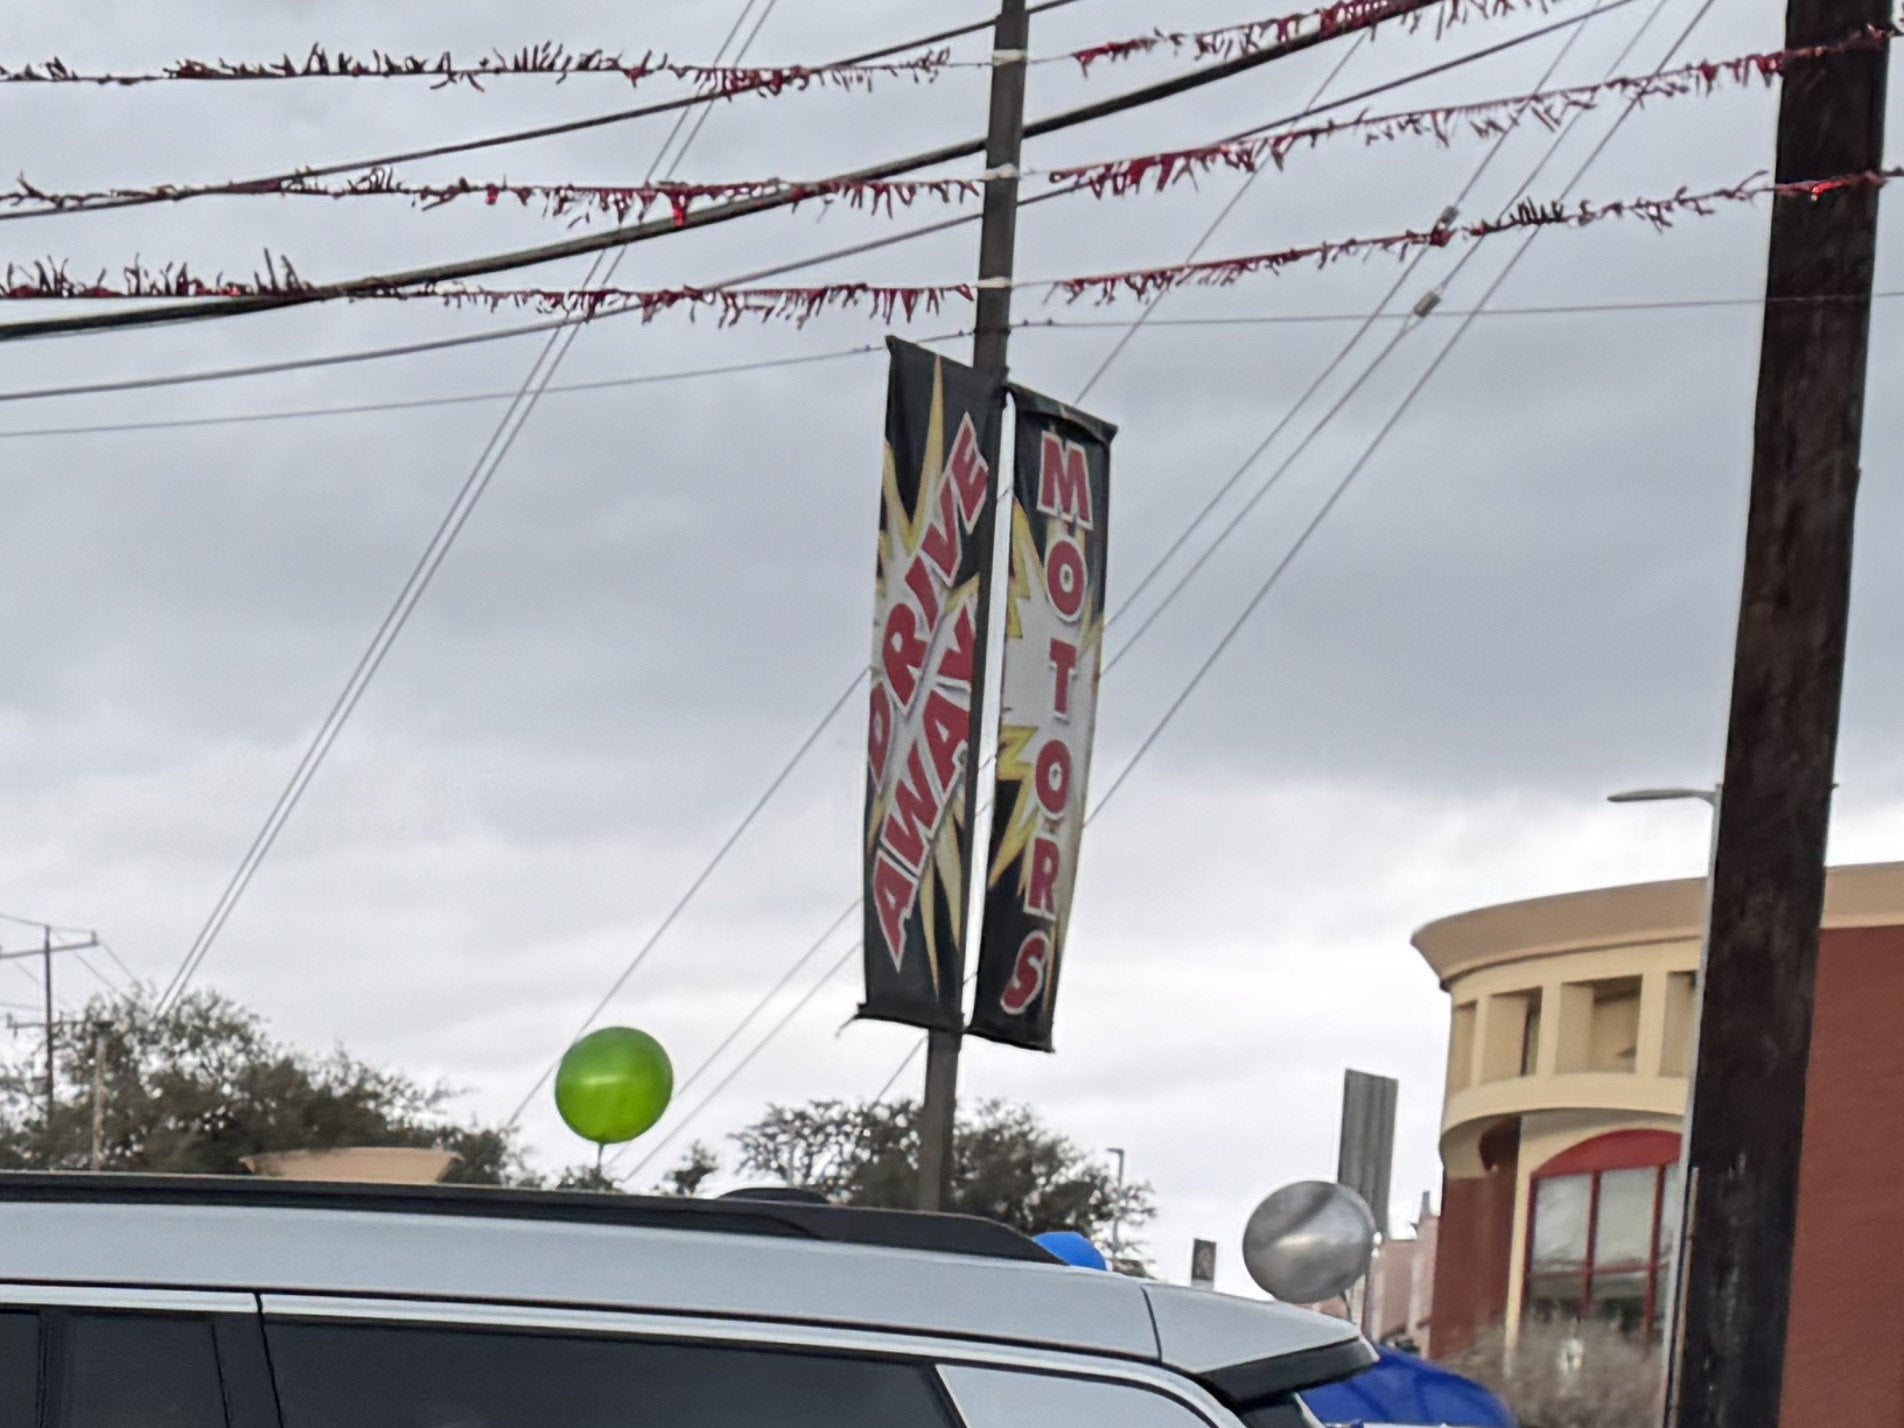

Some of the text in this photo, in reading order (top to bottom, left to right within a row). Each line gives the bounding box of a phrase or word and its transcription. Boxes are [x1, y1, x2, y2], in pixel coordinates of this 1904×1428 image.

[868, 411, 988, 794] DRIVE
[874, 602, 976, 973] AWAY
[1001, 430, 1092, 1016] MOTORS
